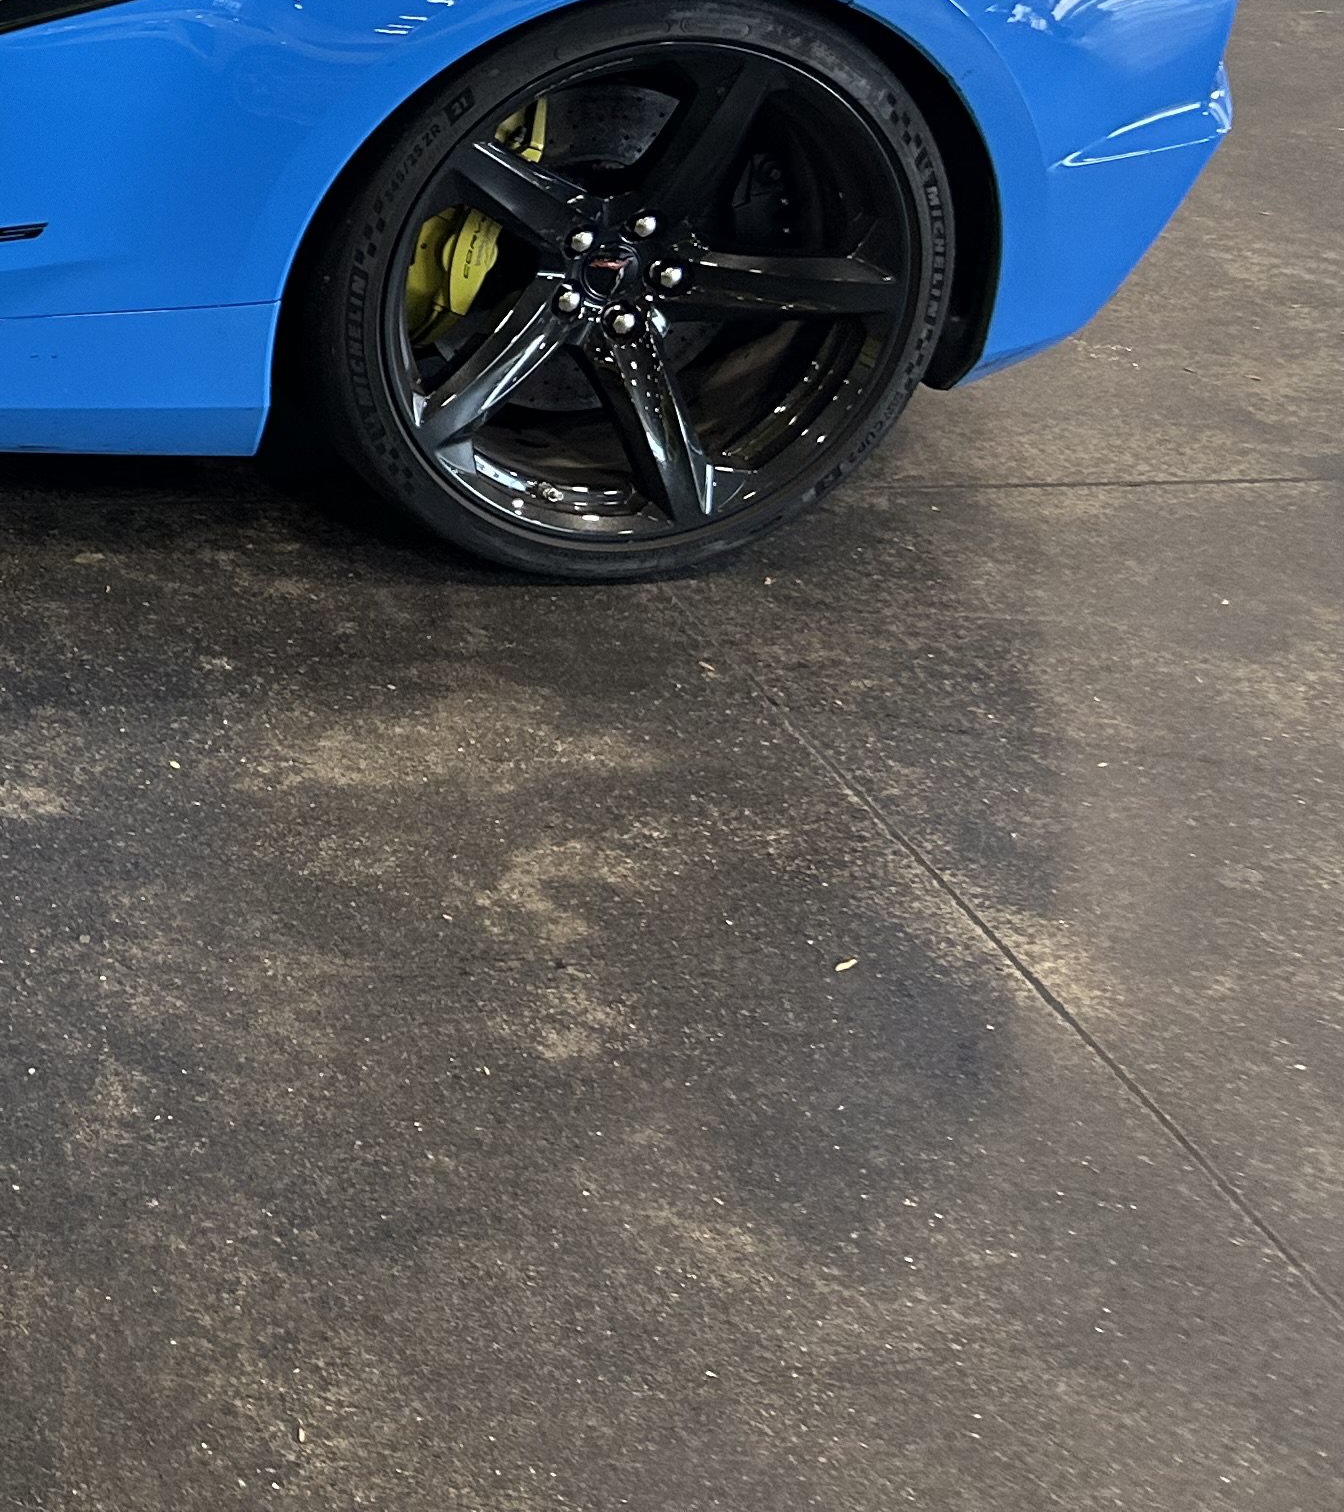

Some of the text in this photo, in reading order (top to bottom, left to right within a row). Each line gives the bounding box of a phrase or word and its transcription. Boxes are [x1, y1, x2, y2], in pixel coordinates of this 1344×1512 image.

[422, 123, 441, 147] ZR
[926, 185, 945, 319] MICHELIN
[347, 273, 373, 407] MICHELIN
[859, 421, 884, 455] CUP
